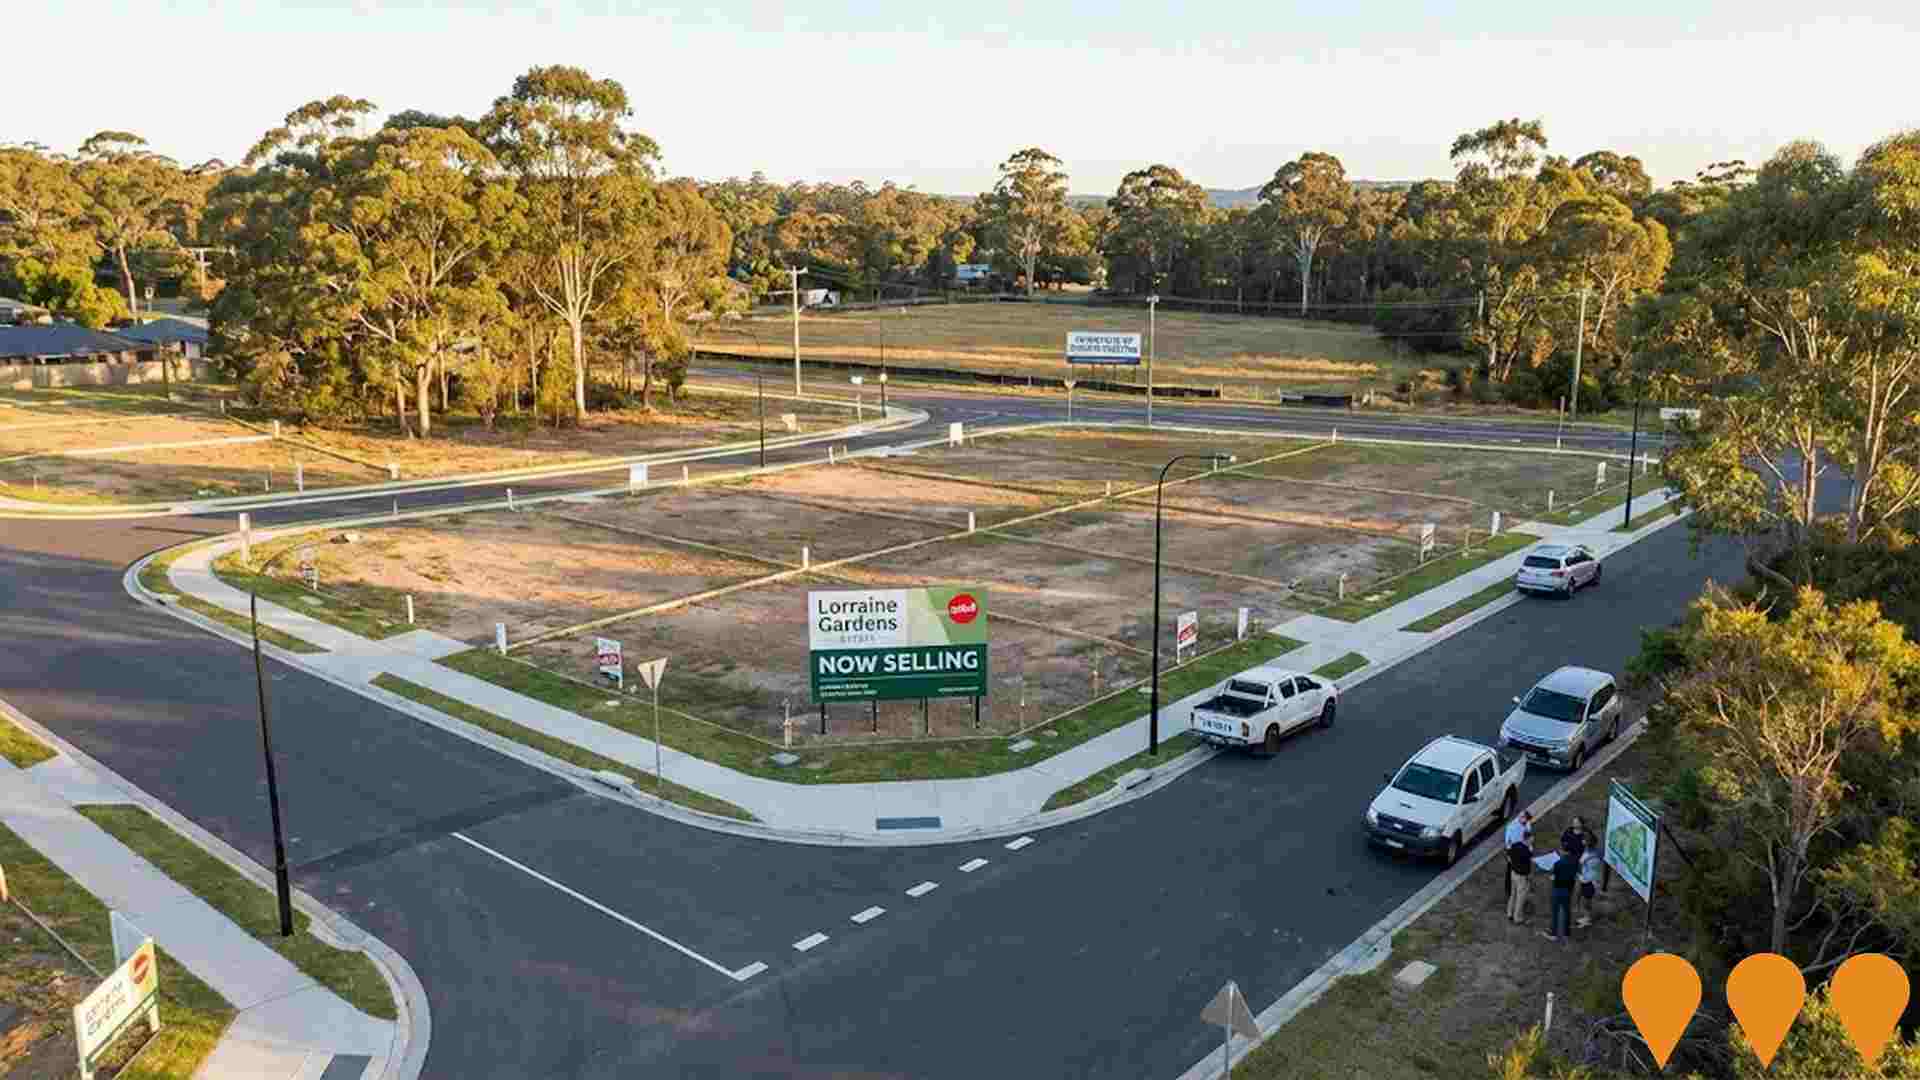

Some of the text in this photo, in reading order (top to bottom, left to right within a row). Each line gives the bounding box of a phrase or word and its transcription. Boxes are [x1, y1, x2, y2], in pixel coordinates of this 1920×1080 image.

[818, 597, 897, 615] Lorraine
[818, 616, 897, 632] Gardens
[819, 650, 978, 674] NOW SELLING
